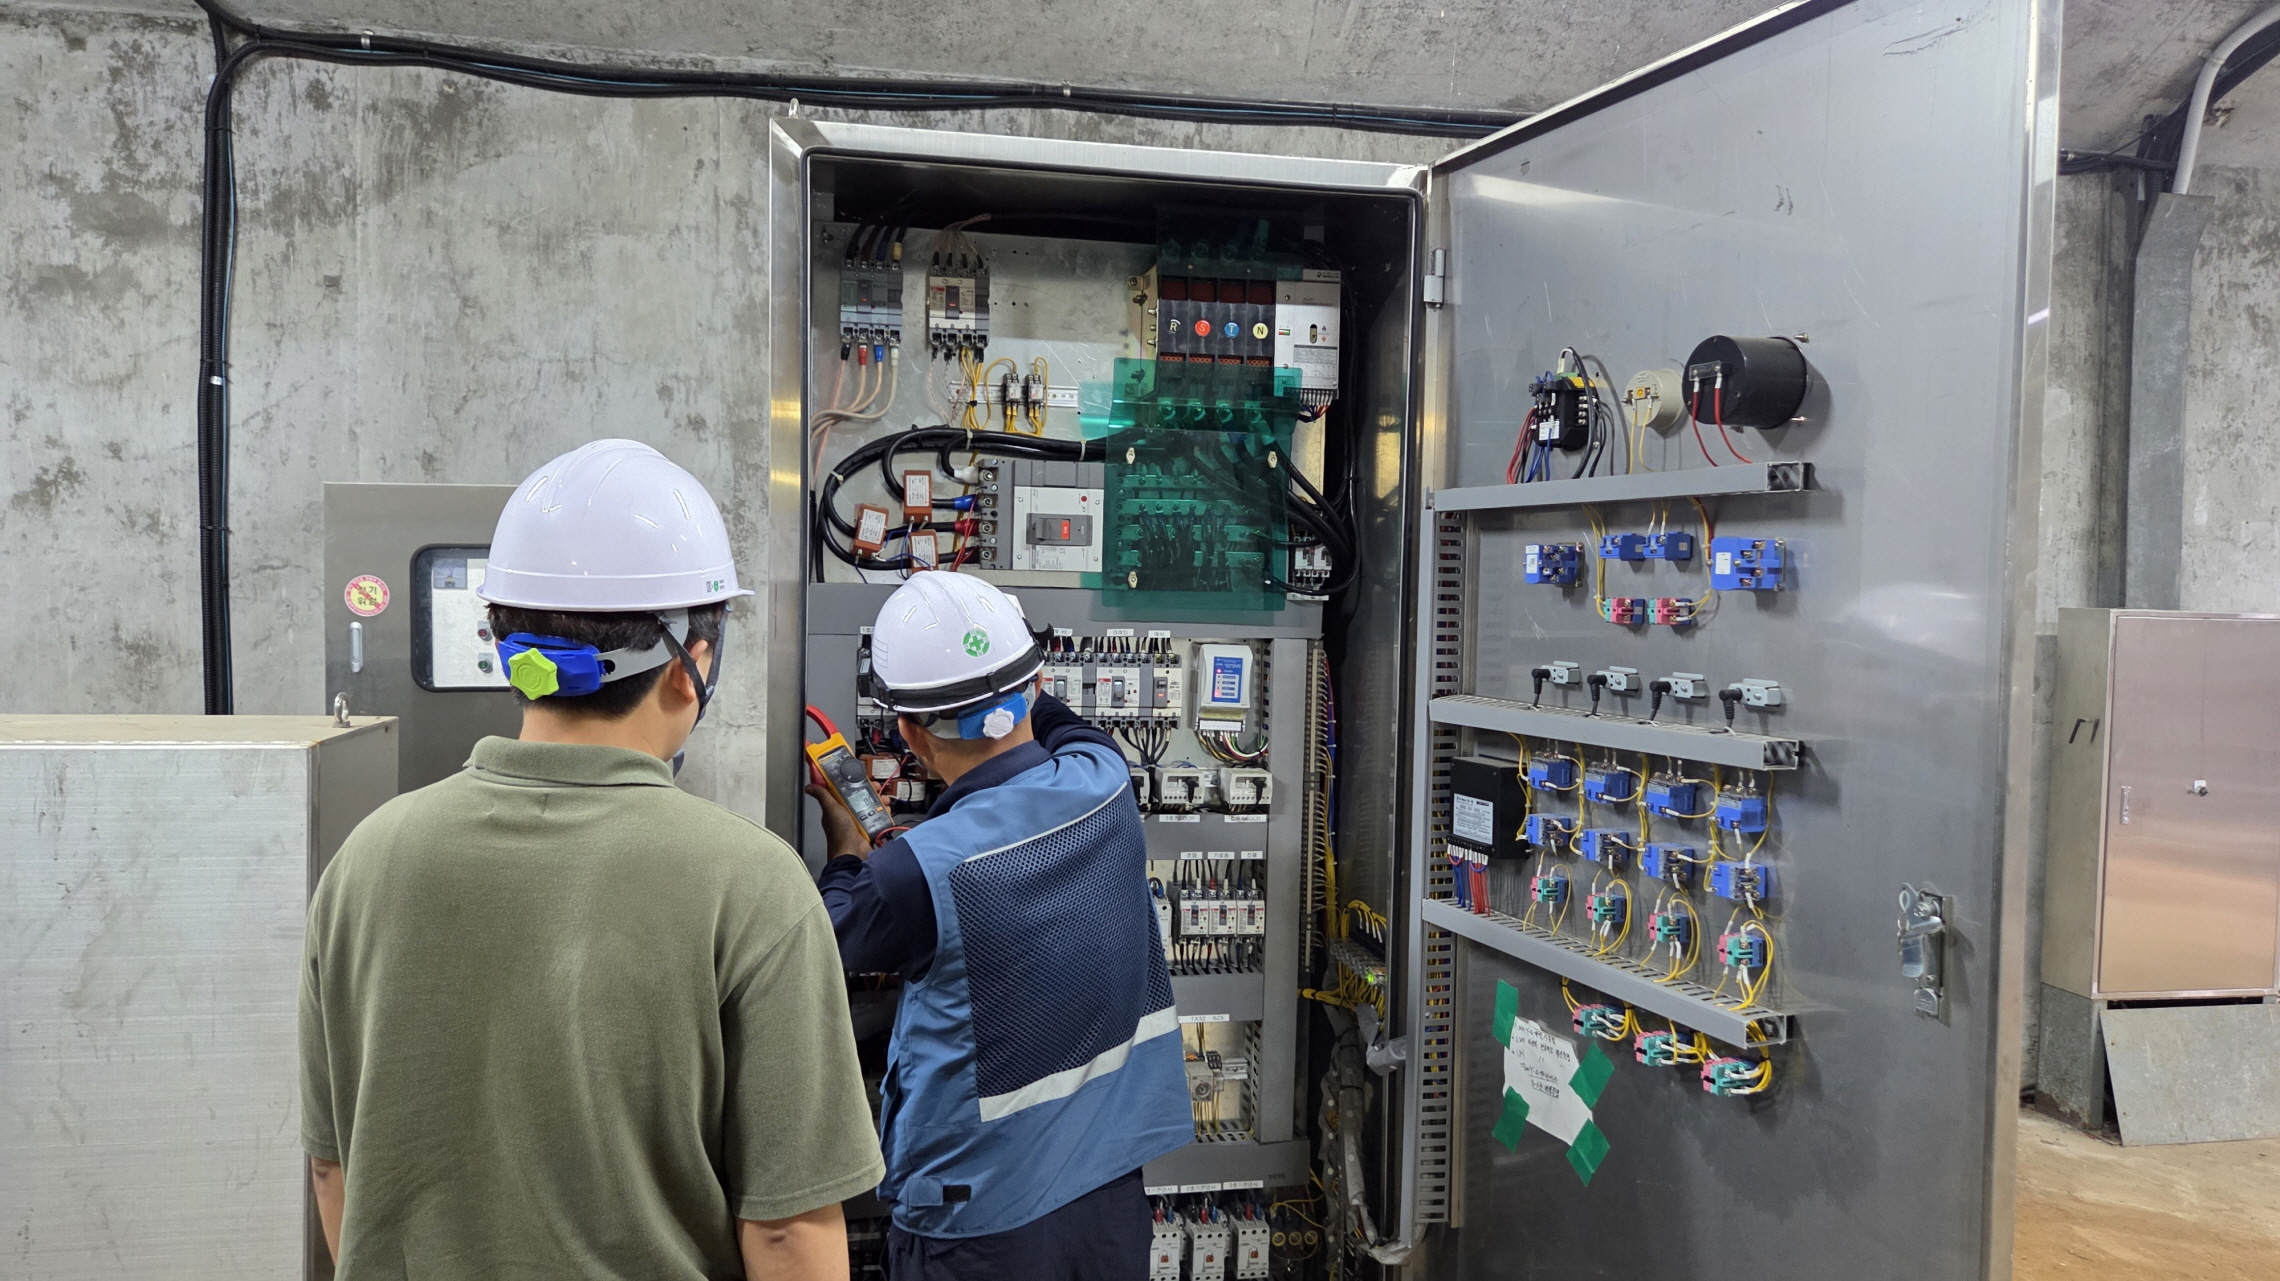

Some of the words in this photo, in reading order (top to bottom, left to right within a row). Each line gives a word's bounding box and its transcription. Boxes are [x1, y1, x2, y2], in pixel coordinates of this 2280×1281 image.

[1169, 322, 1177, 331] R
[1198, 323, 1206, 332] S
[1228, 325, 1235, 334] T
[1257, 326, 1264, 335] N
[358, 586, 377, 595] 전기
[357, 597, 377, 606] 위험
